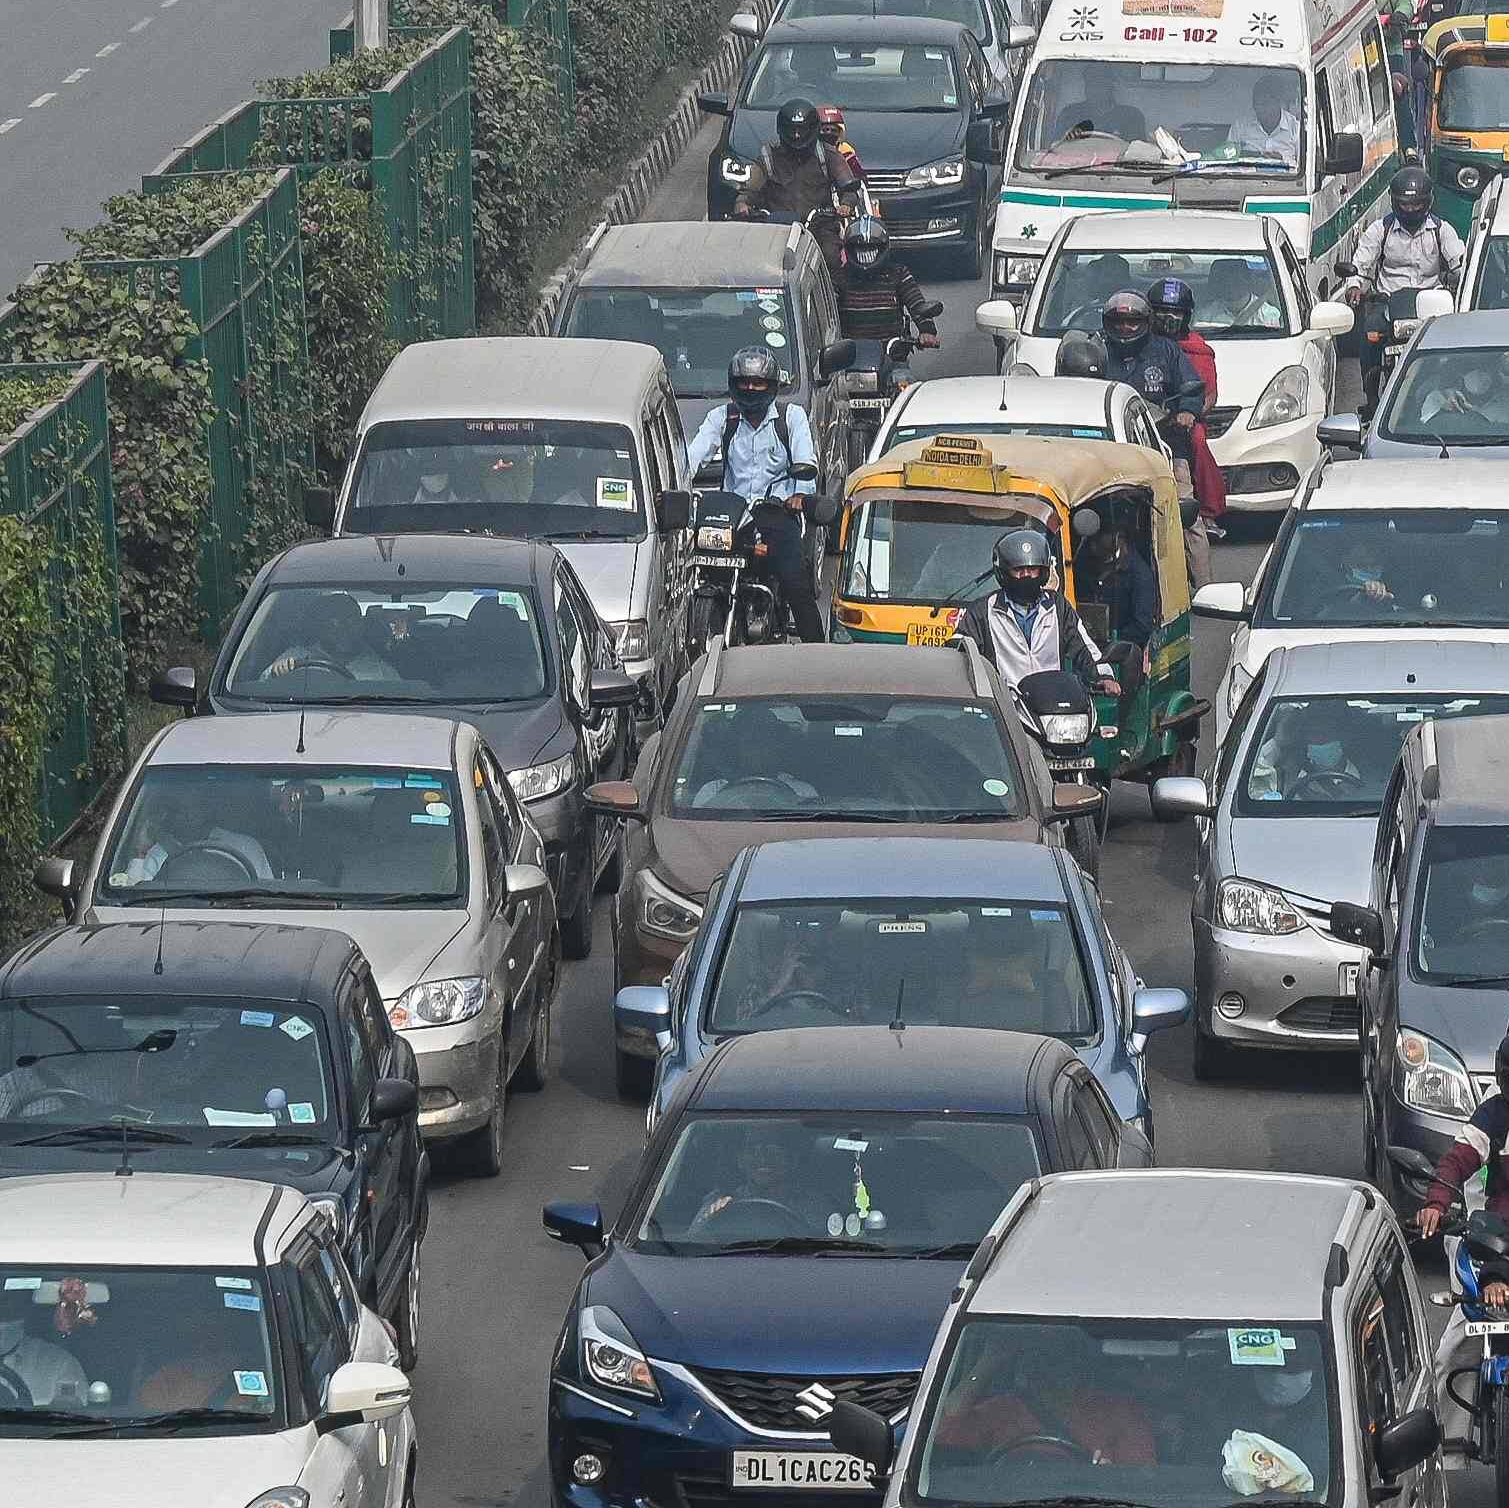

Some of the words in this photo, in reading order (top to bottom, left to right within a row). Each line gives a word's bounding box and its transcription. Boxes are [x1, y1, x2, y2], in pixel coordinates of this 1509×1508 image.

[1059, 32, 1104, 42] CATS
[1124, 26, 1165, 41] Call
[1183, 28, 1218, 44] 102
[1239, 36, 1284, 49] CATS
[1237, 1334, 1273, 1346] CNG
[747, 1458, 878, 1482] DL1CAC265
